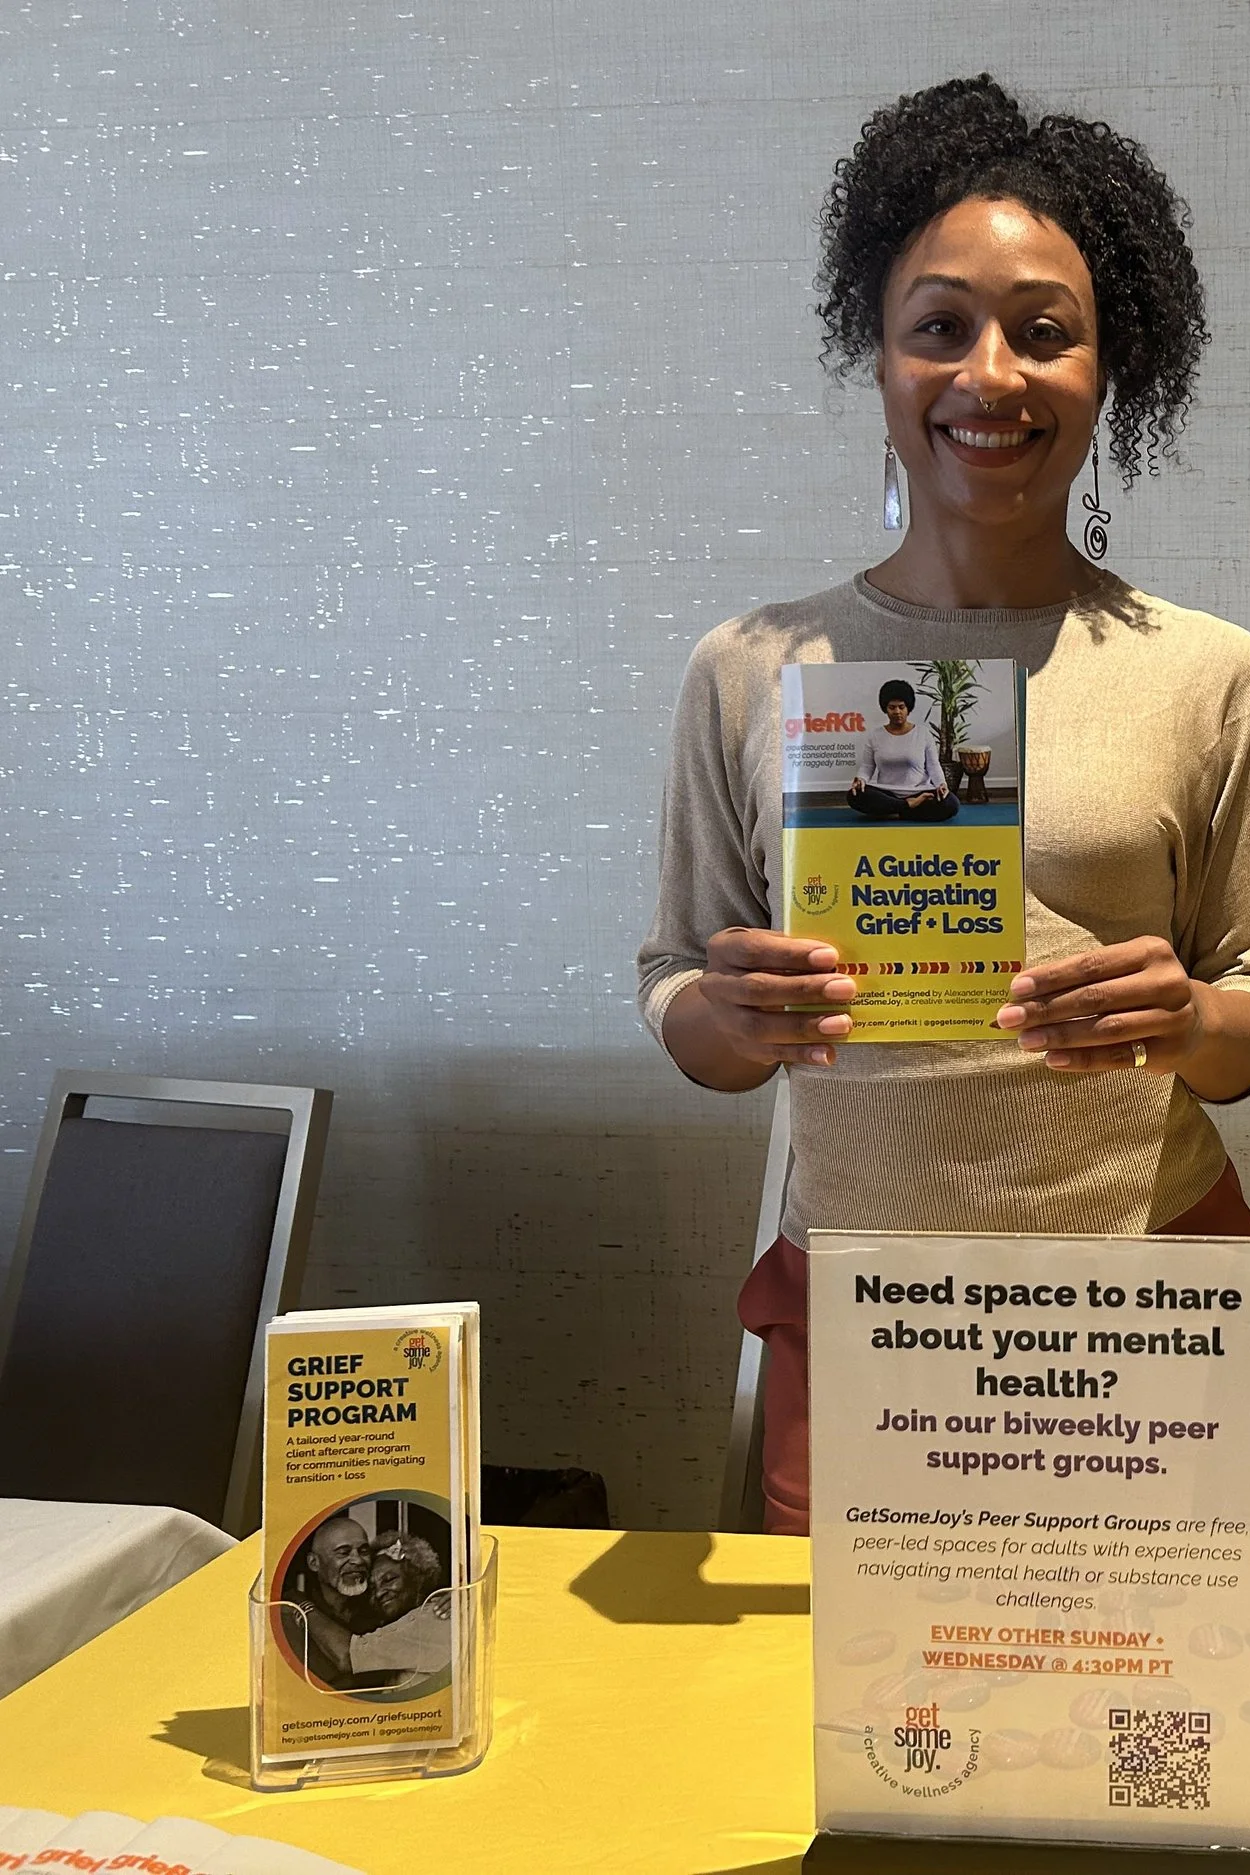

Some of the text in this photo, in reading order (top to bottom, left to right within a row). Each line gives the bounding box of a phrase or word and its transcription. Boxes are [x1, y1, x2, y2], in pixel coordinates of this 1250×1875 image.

[801, 751, 856, 760] considerations
[837, 743, 856, 751] tools
[803, 758, 857, 769] raggedy times
[854, 853, 1001, 878] A Guide for
[851, 883, 997, 915] Navigating
[855, 912, 1004, 935] Grief + Loss
[855, 988, 1010, 999] urated Designed by Alexander Hardy
[852, 1019, 918, 1029] joy.com/griefkit
[855, 1274, 1243, 1315] Need space to share
[870, 1319, 1226, 1361] about your mental
[403, 1347, 431, 1358] some
[287, 1354, 364, 1377] GRIEF
[287, 1377, 410, 1403] SUPPORT
[976, 1366, 1119, 1399] health?
[287, 1402, 417, 1428] PROGRAM
[875, 1407, 1220, 1446] Join our biweekly peer
[286, 1431, 395, 1446] A tailored year-round
[286, 1444, 411, 1459] client aftercare program
[286, 1455, 426, 1471] for communities navigating
[926, 1447, 1168, 1482] support groups.
[286, 1472, 335, 1484] transition
[344, 1471, 366, 1480] loss
[978, 1510, 1021, 1527] Peer
[1024, 1511, 1100, 1533] Support
[1104, 1514, 1172, 1536] Groups
[1176, 1519, 1207, 1533] are
[1210, 1516, 1250, 1538] free,
[852, 1534, 1243, 1563] peer-led spaces for adults with experiences
[857, 1560, 1240, 1588] navigating mental health or substance use
[995, 1590, 1098, 1613] challenges.
[931, 1625, 993, 1642] EVERY
[998, 1627, 1065, 1644] OTHER
[1070, 1630, 1152, 1647] SUNDAY
[922, 1651, 1174, 1675] WEDNESDAY @ 4:30PM PT
[282, 1709, 442, 1733] getsomejoy.com/griefsupport
[906, 1702, 941, 1729] get
[894, 1727, 951, 1750] some
[863, 1725, 982, 1798] a creative wellness agency
[904, 1748, 941, 1774] joy.
